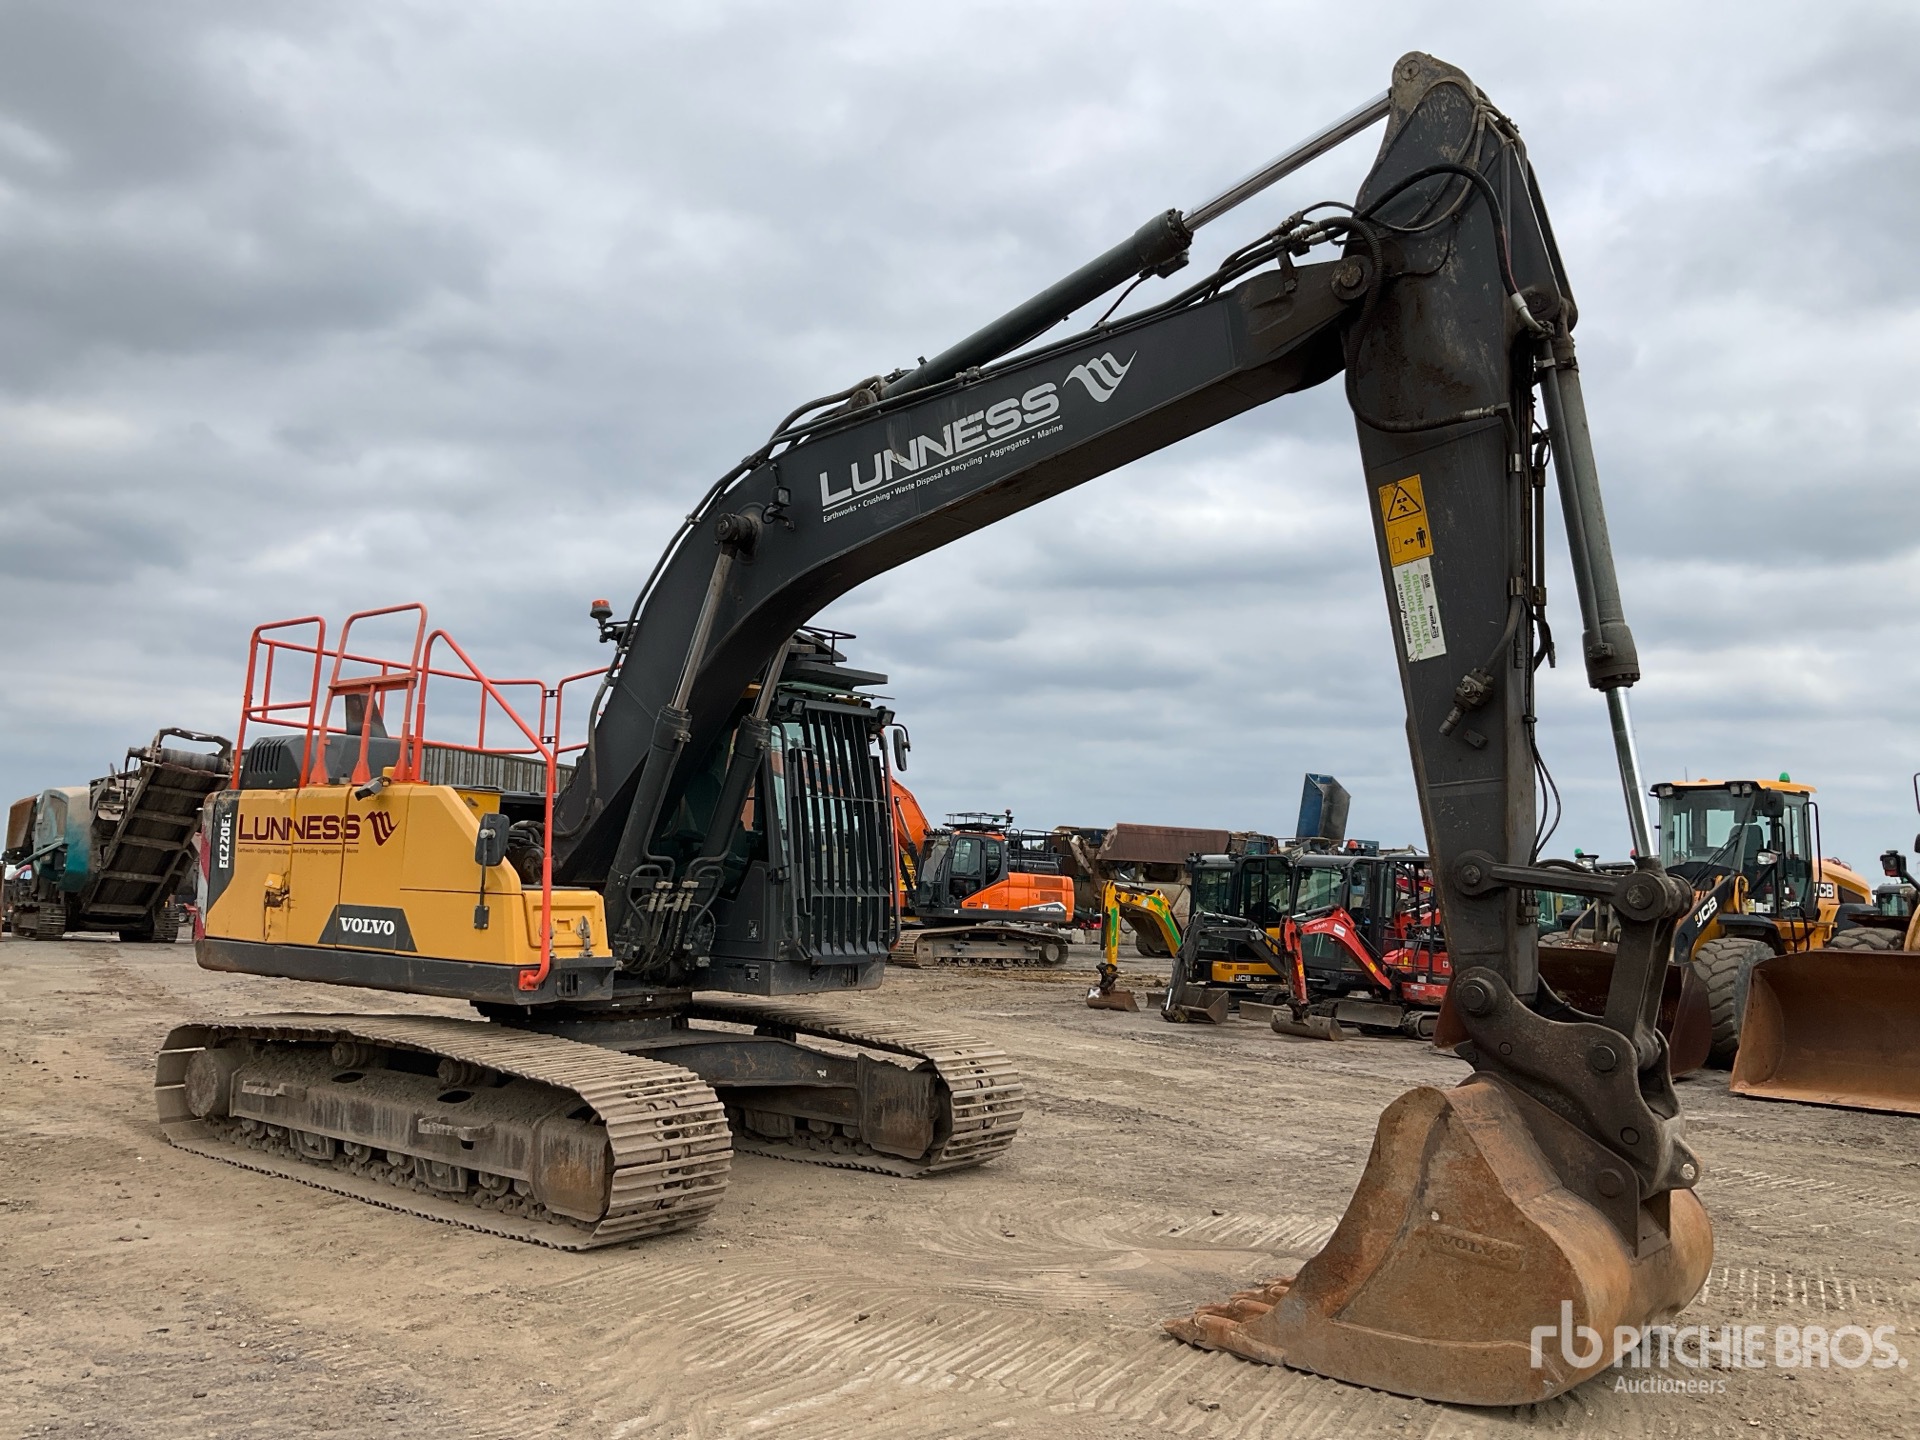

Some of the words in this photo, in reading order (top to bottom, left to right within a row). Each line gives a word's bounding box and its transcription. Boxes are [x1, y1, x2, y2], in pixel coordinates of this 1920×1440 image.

[820, 383, 1060, 506] LUNNESS
[823, 505, 857, 523] Earthworks
[863, 491, 890, 508] Crushing
[894, 483, 915, 496] Waste
[916, 472, 943, 488] Disposal
[944, 468, 950, 476] &
[951, 456, 983, 474] Recycling
[990, 437, 1030, 459] Aggregates
[1037, 424, 1064, 440] Marine
[1402, 570, 1416, 615] TWINLOCK
[1409, 614, 1424, 654] COUPLER
[1411, 574, 1425, 611] GENUINE
[1418, 613, 1431, 646] MILLER
[238, 814, 361, 840] LUNNESS
[339, 916, 395, 936] VOLVO
[1696, 896, 1718, 929] JCB
[1235, 974, 1251, 982] JCB
[1440, 1235, 1511, 1261] VOLVO
